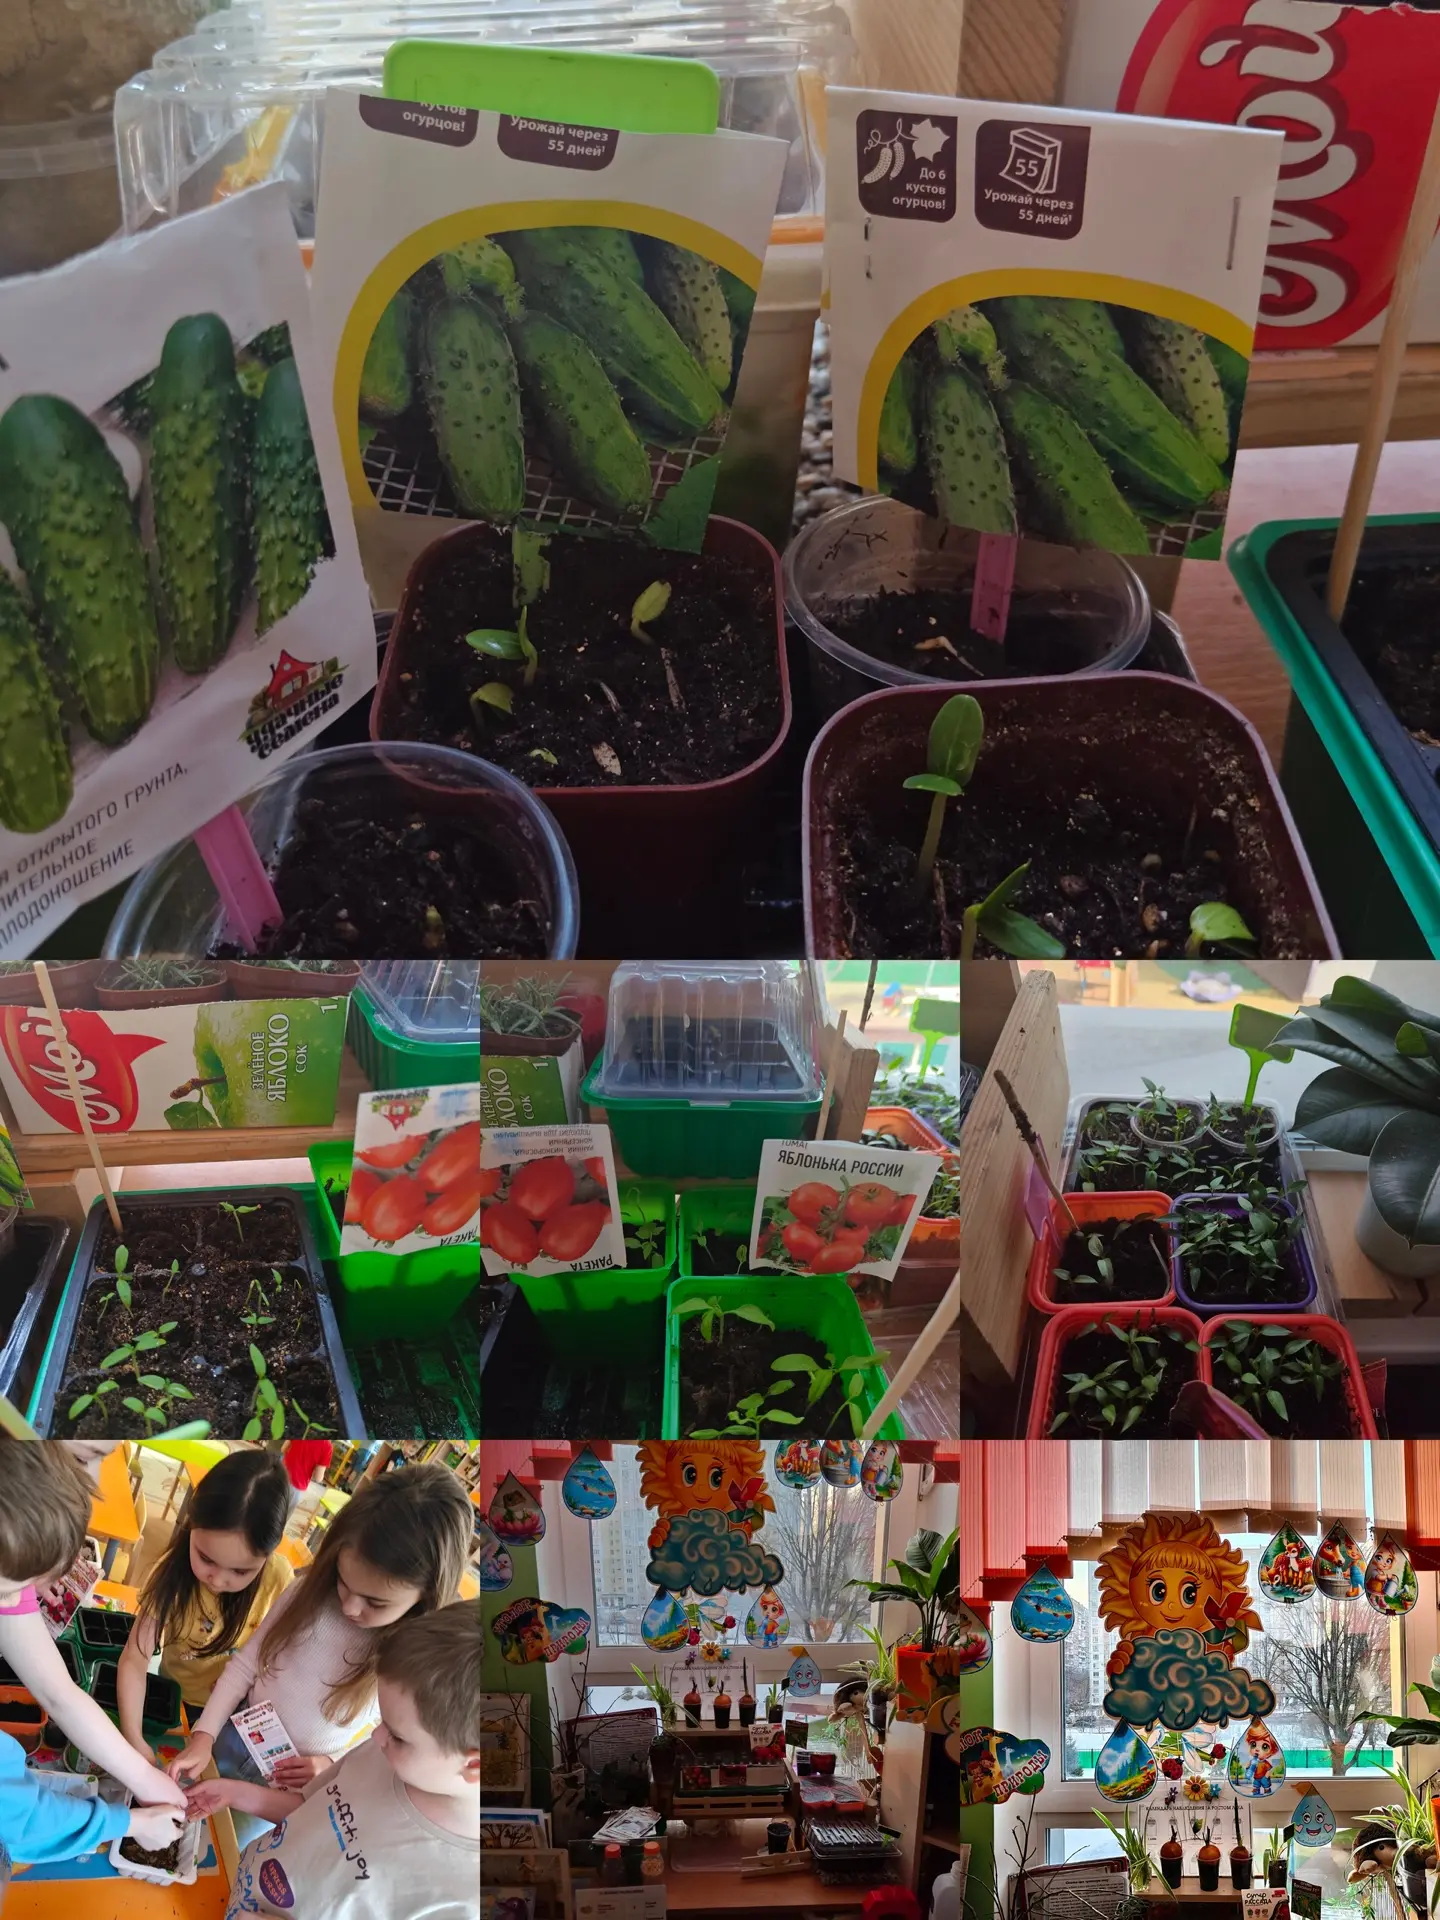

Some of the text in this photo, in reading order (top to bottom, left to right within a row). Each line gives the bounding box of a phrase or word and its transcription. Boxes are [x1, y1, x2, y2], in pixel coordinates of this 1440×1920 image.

[402, 111, 467, 134] огурцов!
[509, 113, 610, 144] Урожай через
[547, 138, 565, 153] 55
[918, 166, 947, 181] До 6
[1014, 158, 1040, 178] 55
[905, 182, 947, 196] кустов
[983, 186, 1075, 213] Урожай через
[892, 195, 947, 212] огурцов!
[1017, 209, 1035, 223] 55
[256, 694, 341, 761] семена
[16, 801, 118, 874] ОТКРЫТОГО
[123, 762, 189, 810] ГРУНТА,
[246, 1032, 266, 1090] ЗЕЛЁНОЕ
[266, 1013, 290, 1102] ЯБЛОКО
[295, 1043, 308, 1074] СОК
[520, 1095, 535, 1120] СОК
[567, 1145, 594, 1154] РАННИЙ
[777, 1149, 905, 1179] ЯБЛОНЬКА РОССИИ
[569, 1253, 613, 1273] РАКЕТА
[493, 1598, 533, 1634] УГОЛОК
[543, 1617, 590, 1657] ПРИРОДЫ
[992, 1749, 1049, 1799] ПРИРОДЫ
[325, 1783, 359, 1845] graffiti
[345, 1848, 371, 1880] joy
